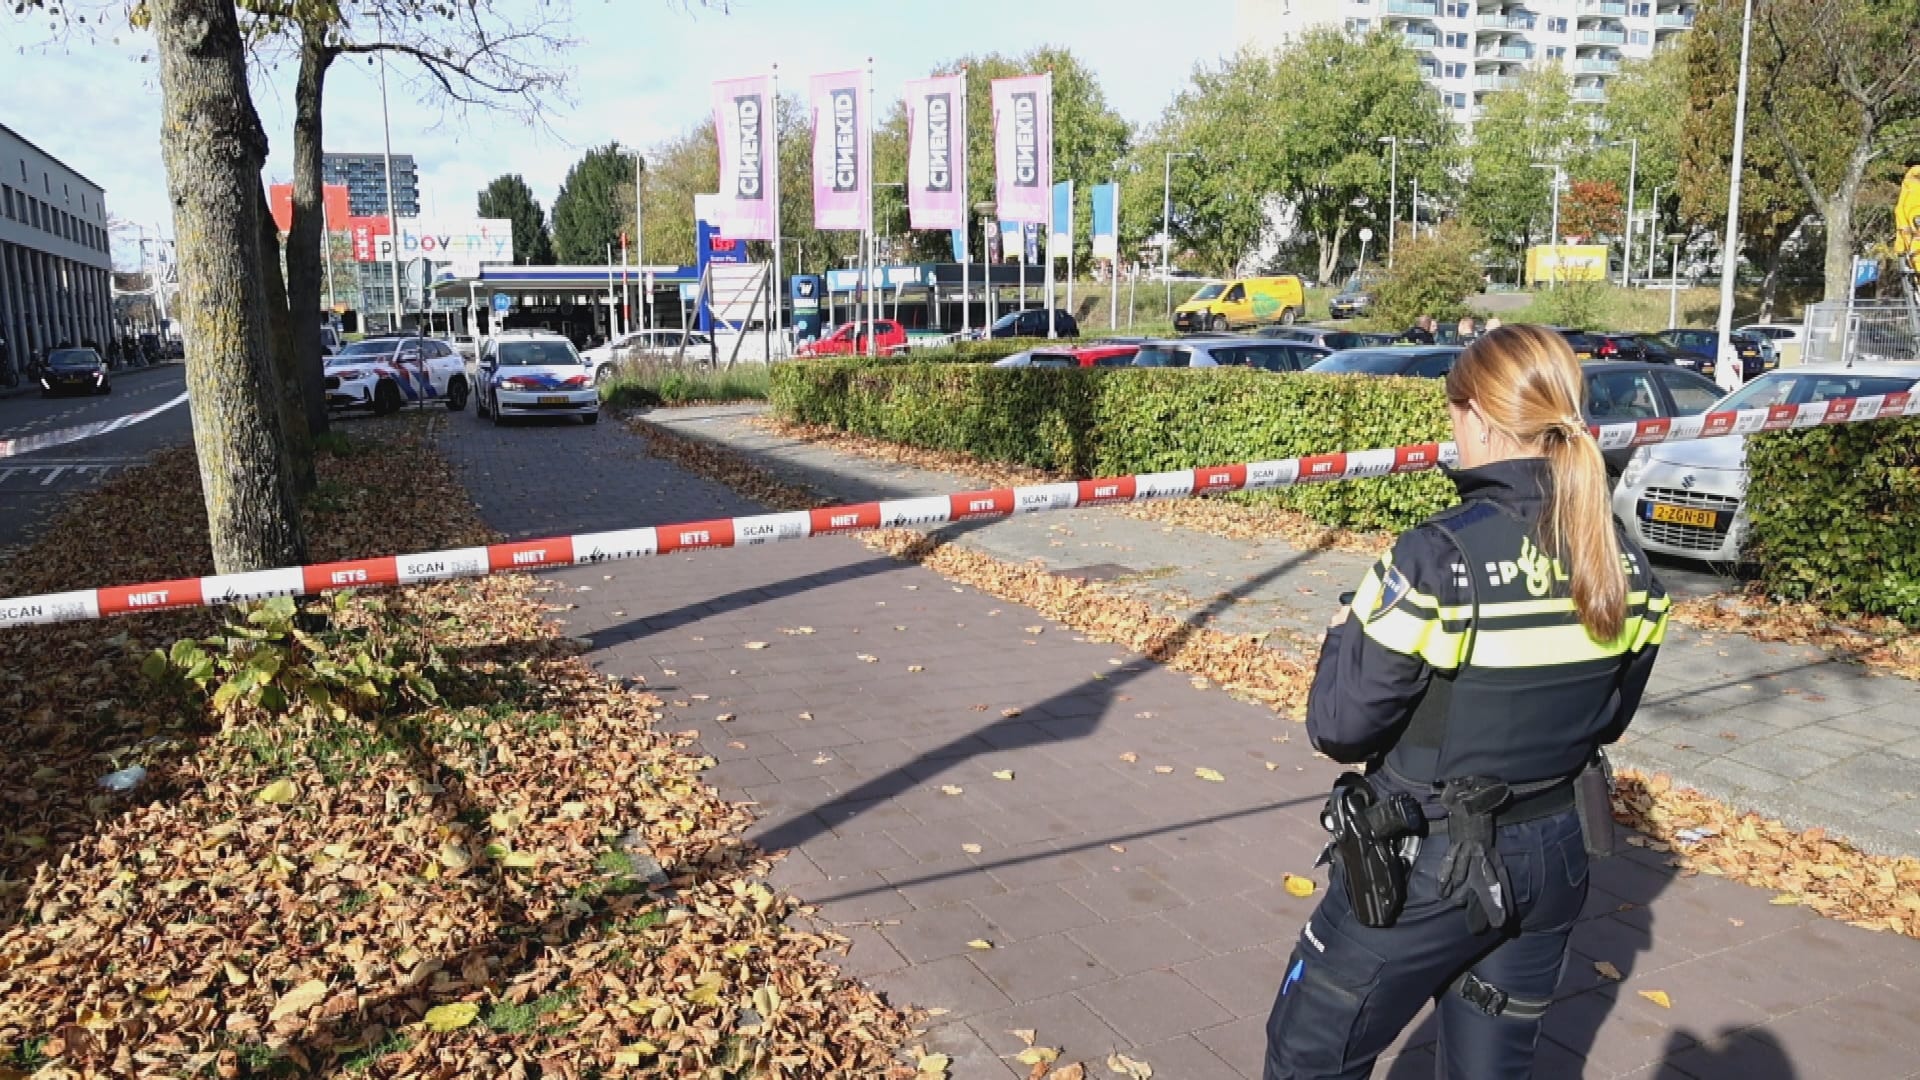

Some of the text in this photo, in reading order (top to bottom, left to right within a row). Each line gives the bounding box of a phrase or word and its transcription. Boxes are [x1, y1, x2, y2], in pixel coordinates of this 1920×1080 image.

[739, 100, 760, 195] CINEKID
[835, 93, 856, 188] CINEKID
[929, 97, 949, 188] CINEKID
[1016, 96, 1036, 184] CINEKID
[1253, 469, 1273, 479] SCAN
[1094, 485, 1119, 498] NIET
[1022, 494, 1048, 506] SCAN
[830, 513, 860, 528] NIET
[1656, 506, 1711, 525] 2-ZGN-81
[679, 530, 711, 546] IETS
[743, 524, 775, 537] SCAN
[513, 549, 547, 565] NIET
[407, 561, 445, 576] SCAN
[1498, 535, 1633, 596] POLE
[331, 569, 368, 585] IETS
[127, 590, 169, 608] NIET
[0, 605, 43, 621] SCAN
